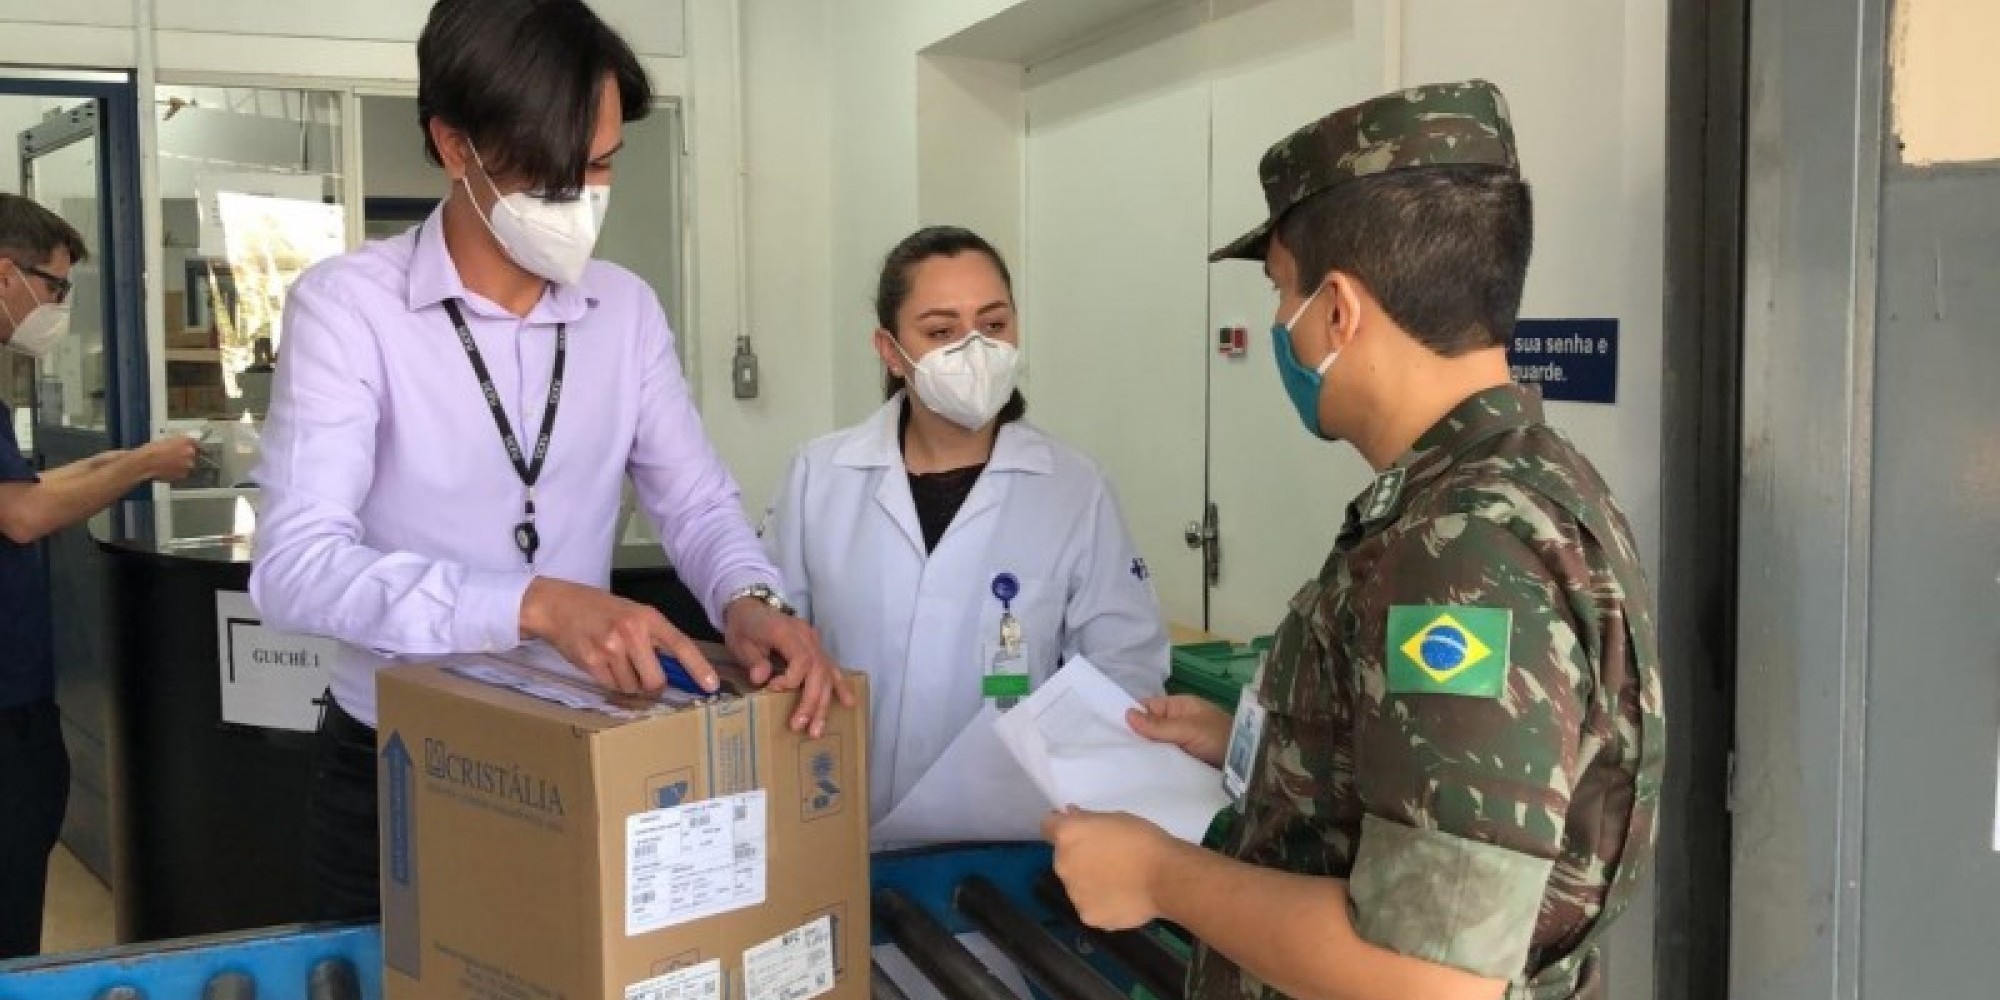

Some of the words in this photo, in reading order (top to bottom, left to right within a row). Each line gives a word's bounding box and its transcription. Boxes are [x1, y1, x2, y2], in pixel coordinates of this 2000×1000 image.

[1514, 337, 1541, 353] sua
[1545, 332, 1593, 353] senha
[1597, 337, 1608, 354] e
[252, 648, 308, 668] GUICHÊ
[447, 752, 565, 816] CRISTÁLIA
